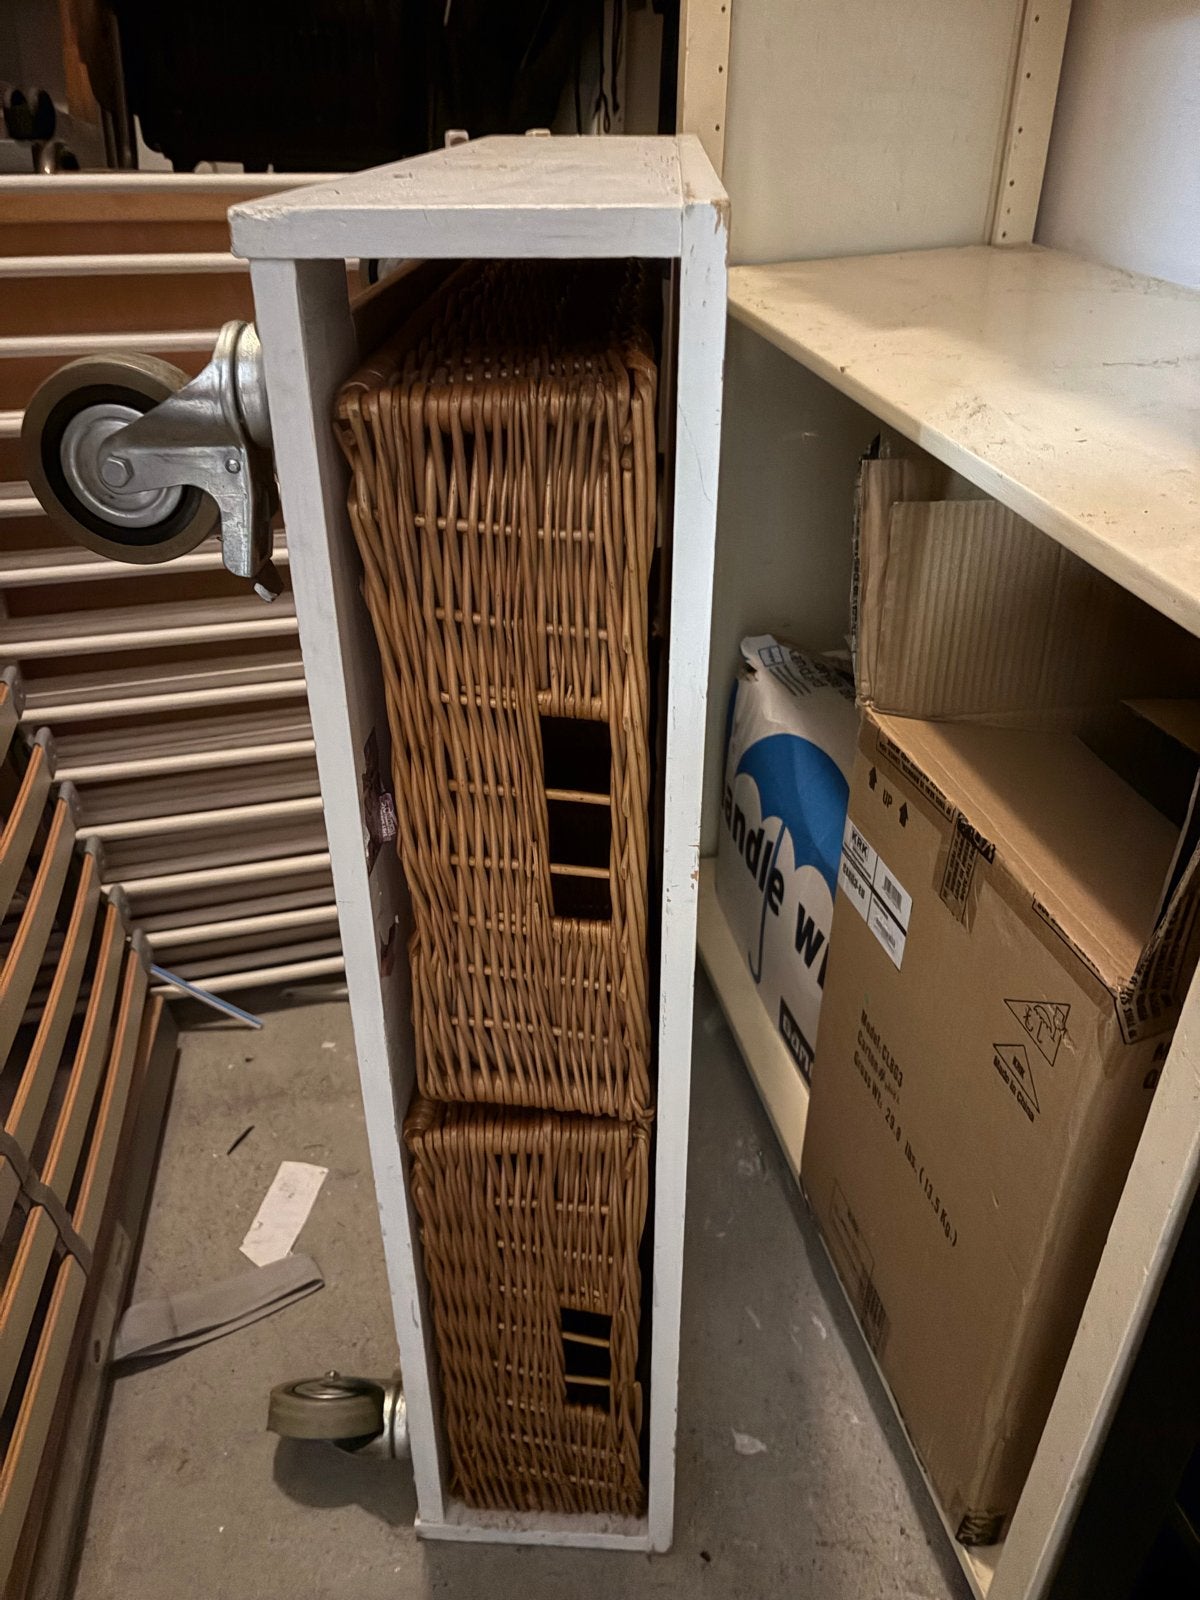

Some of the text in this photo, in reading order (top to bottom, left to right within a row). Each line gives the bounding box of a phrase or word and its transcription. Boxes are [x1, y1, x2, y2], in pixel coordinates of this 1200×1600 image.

[883, 789, 893, 809] UP
[851, 829, 868, 855] KRK
[1016, 1090, 1035, 1123] China
